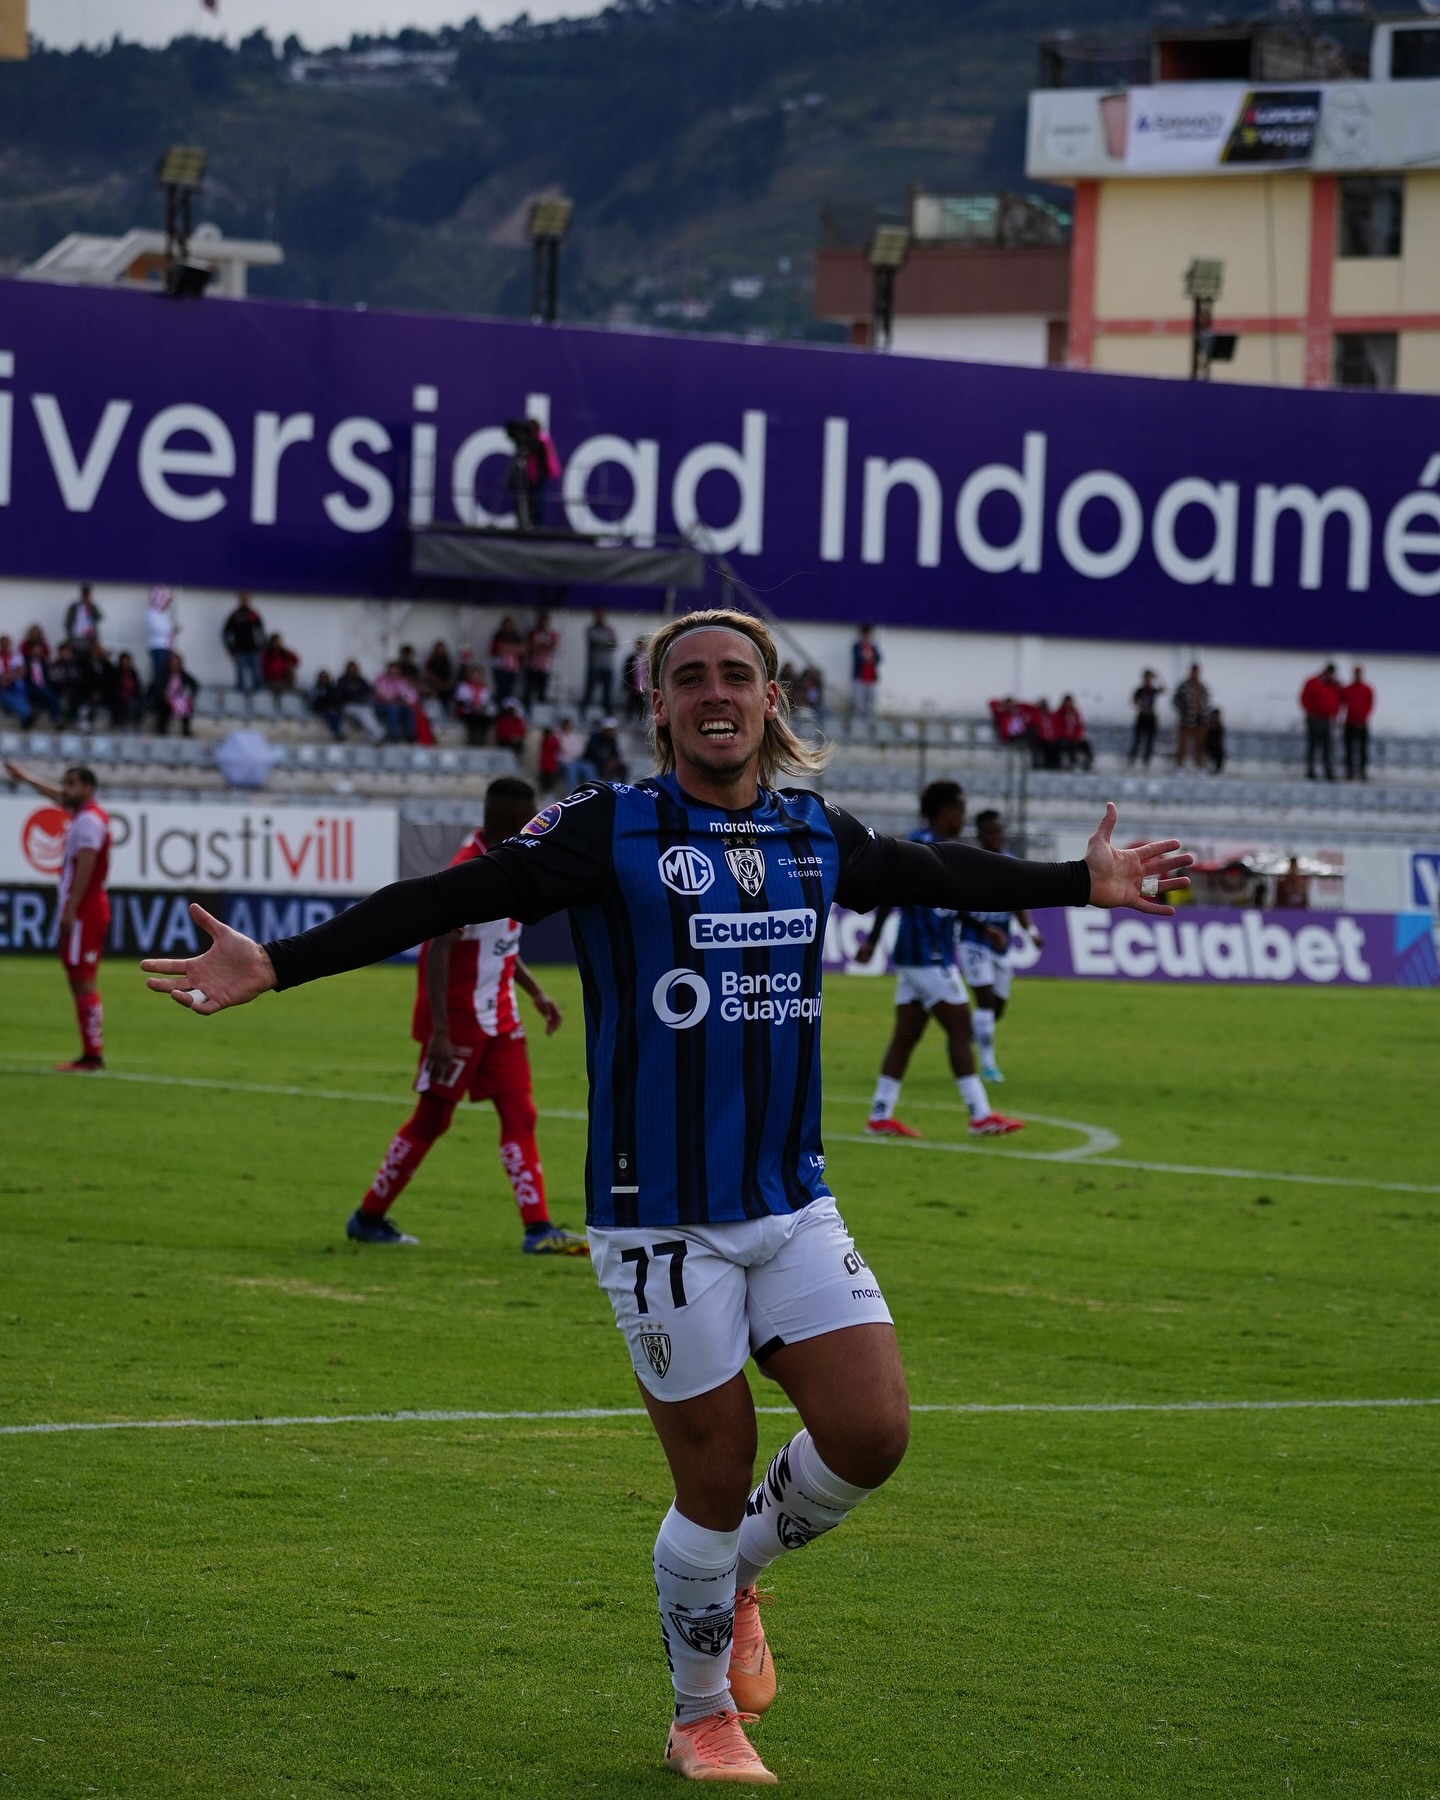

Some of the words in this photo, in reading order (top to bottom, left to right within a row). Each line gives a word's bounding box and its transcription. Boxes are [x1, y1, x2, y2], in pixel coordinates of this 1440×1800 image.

[709, 820, 775, 834] marathon
[663, 849, 709, 890] MG
[777, 856, 823, 866] CHUBB
[787, 869, 823, 879] SEGUROS
[694, 914, 813, 944] Ecuabet
[1066, 910, 1372, 982] Ecuabet
[721, 971, 801, 997] Banco
[620, 1239, 689, 1315] 77
